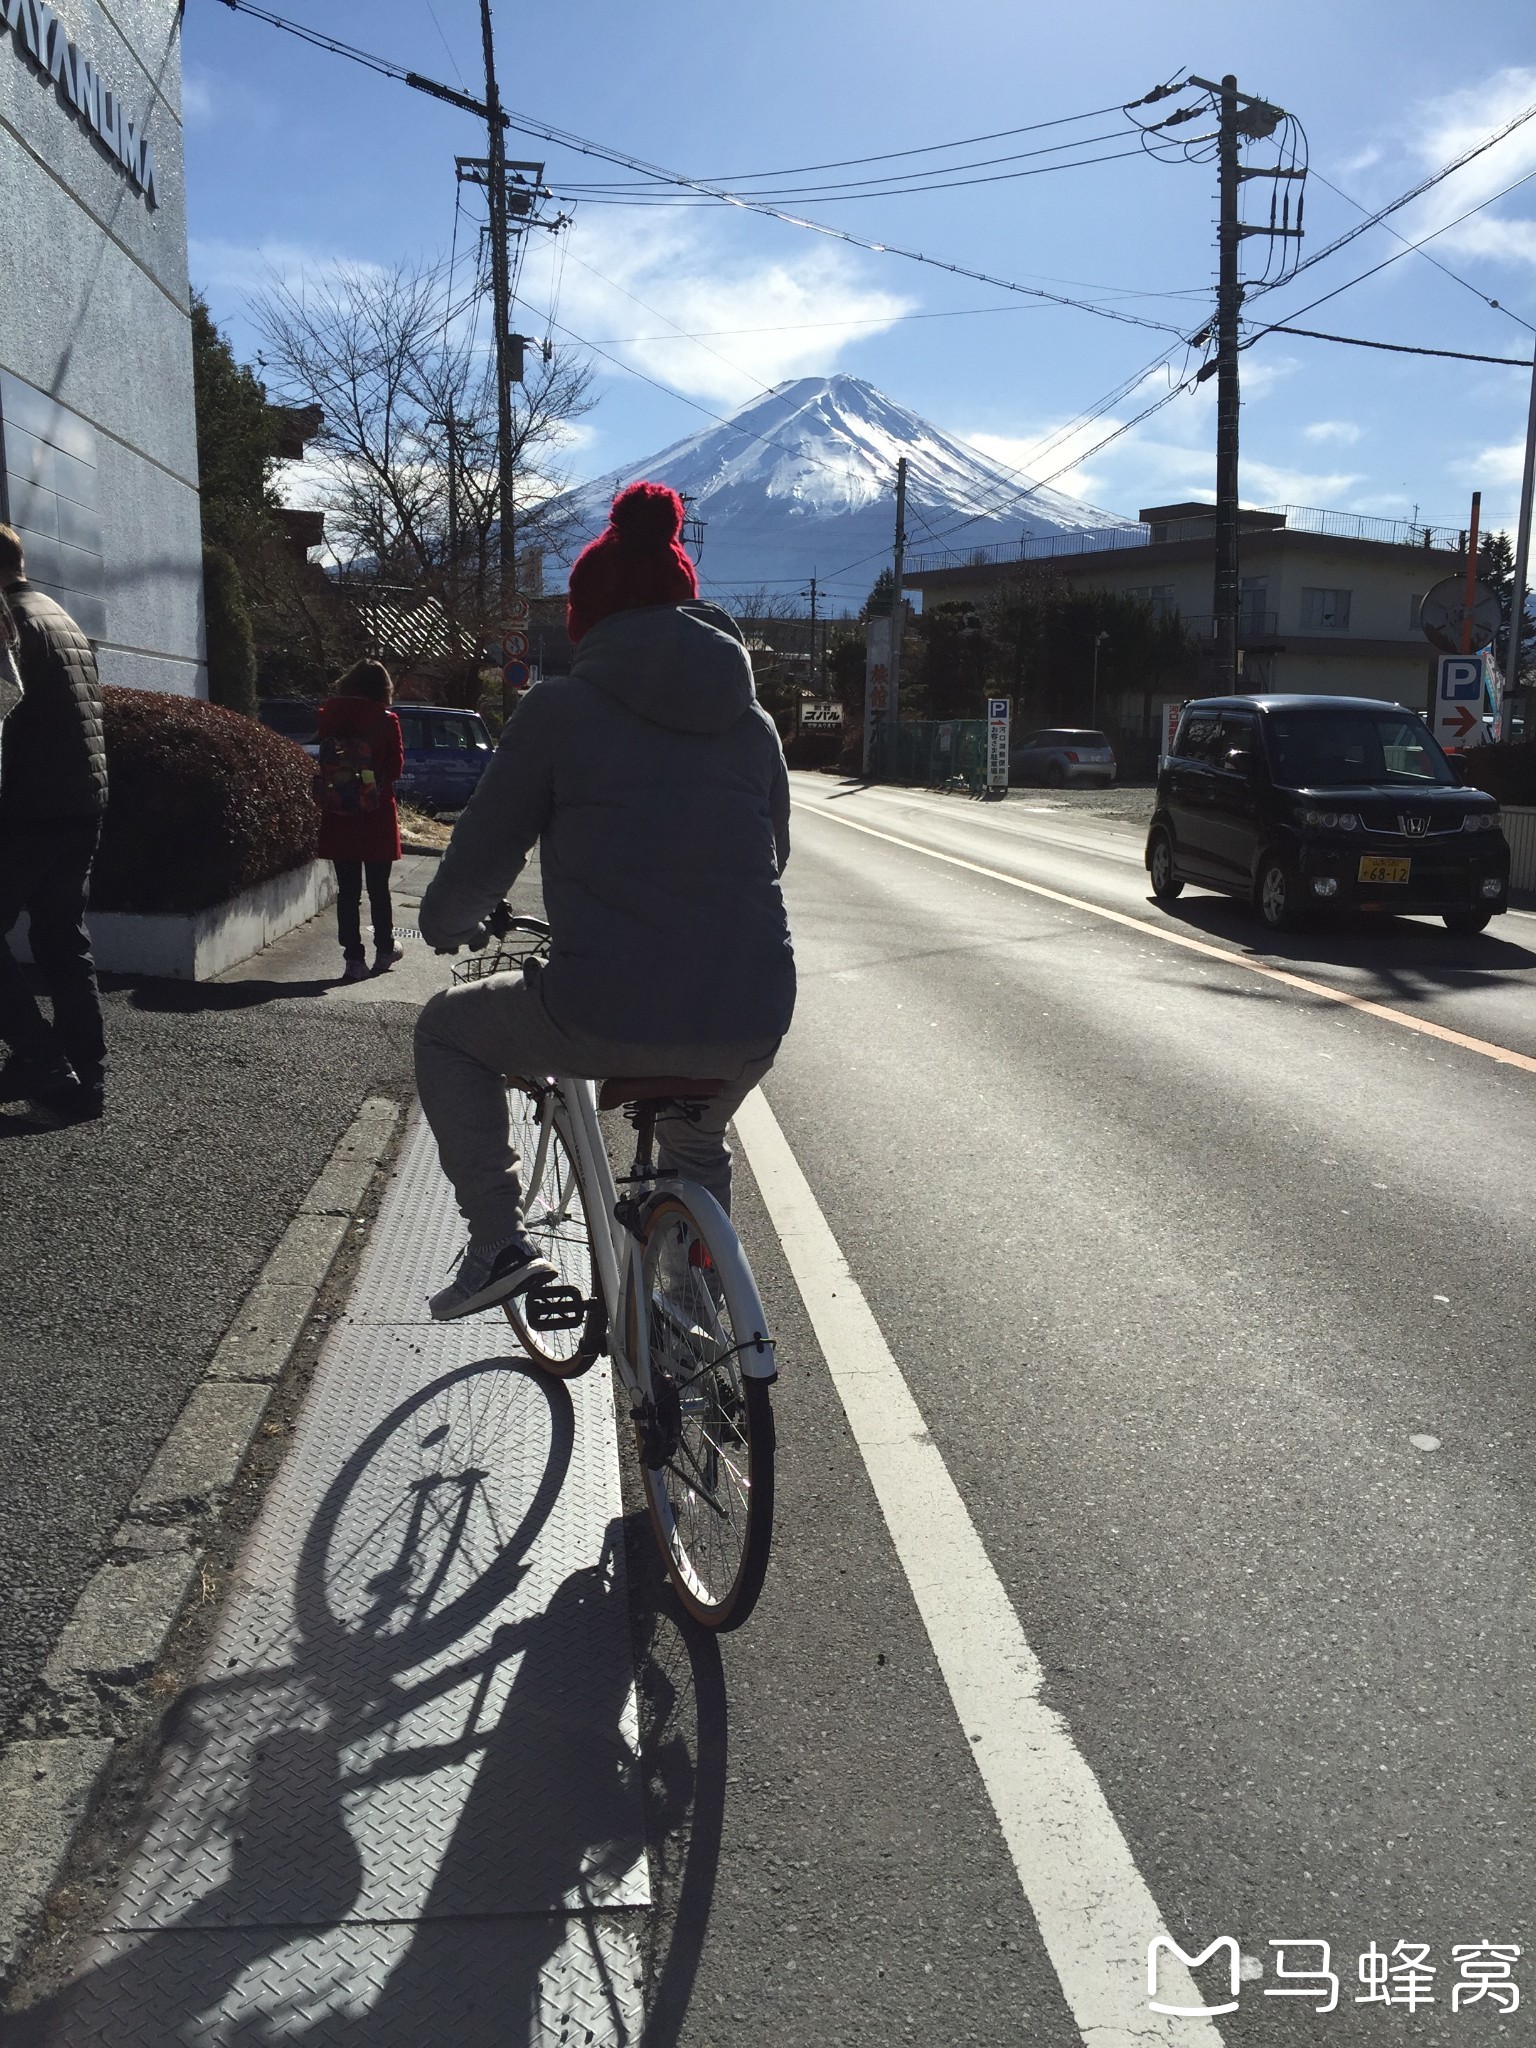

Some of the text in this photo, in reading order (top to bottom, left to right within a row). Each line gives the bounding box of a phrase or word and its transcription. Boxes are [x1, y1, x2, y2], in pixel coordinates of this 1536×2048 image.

[0, 0, 159, 209] AYANUMA
[1446, 662, 1476, 698] P
[804, 711, 840, 721] スバル
[992, 702, 1005, 717] P
[1370, 868, 1407, 881] 68-12
